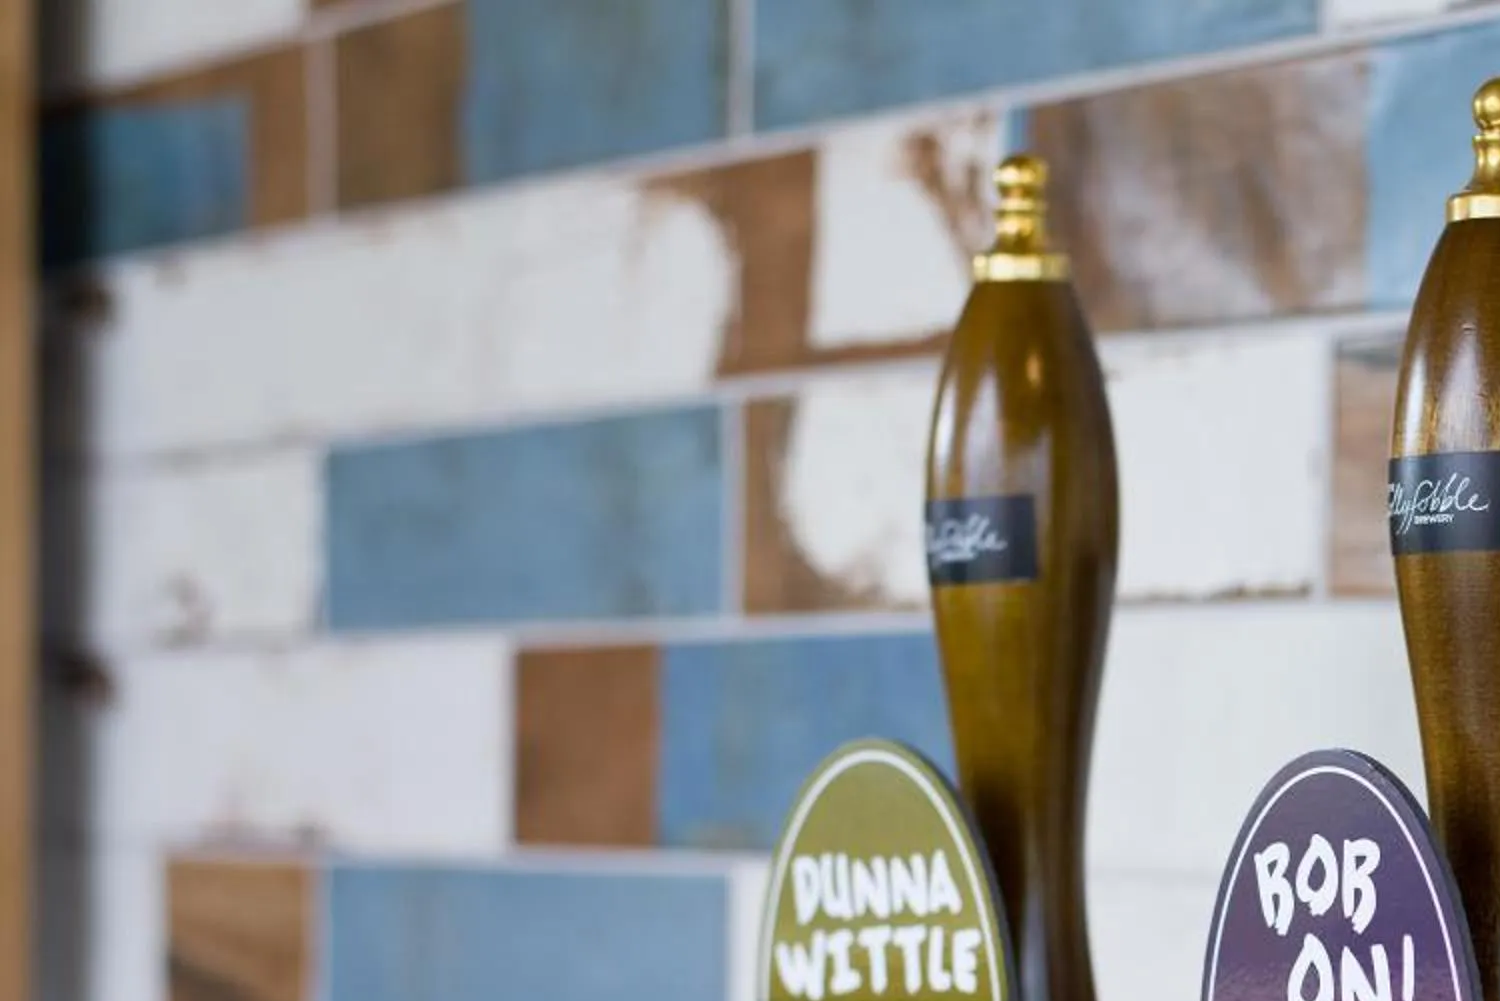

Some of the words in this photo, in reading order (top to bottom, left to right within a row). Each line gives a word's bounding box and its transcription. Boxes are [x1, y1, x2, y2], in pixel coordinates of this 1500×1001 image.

[1413, 513, 1455, 526] BREWERY
[792, 848, 963, 926] DUNNA
[1254, 834, 1381, 936] BOB
